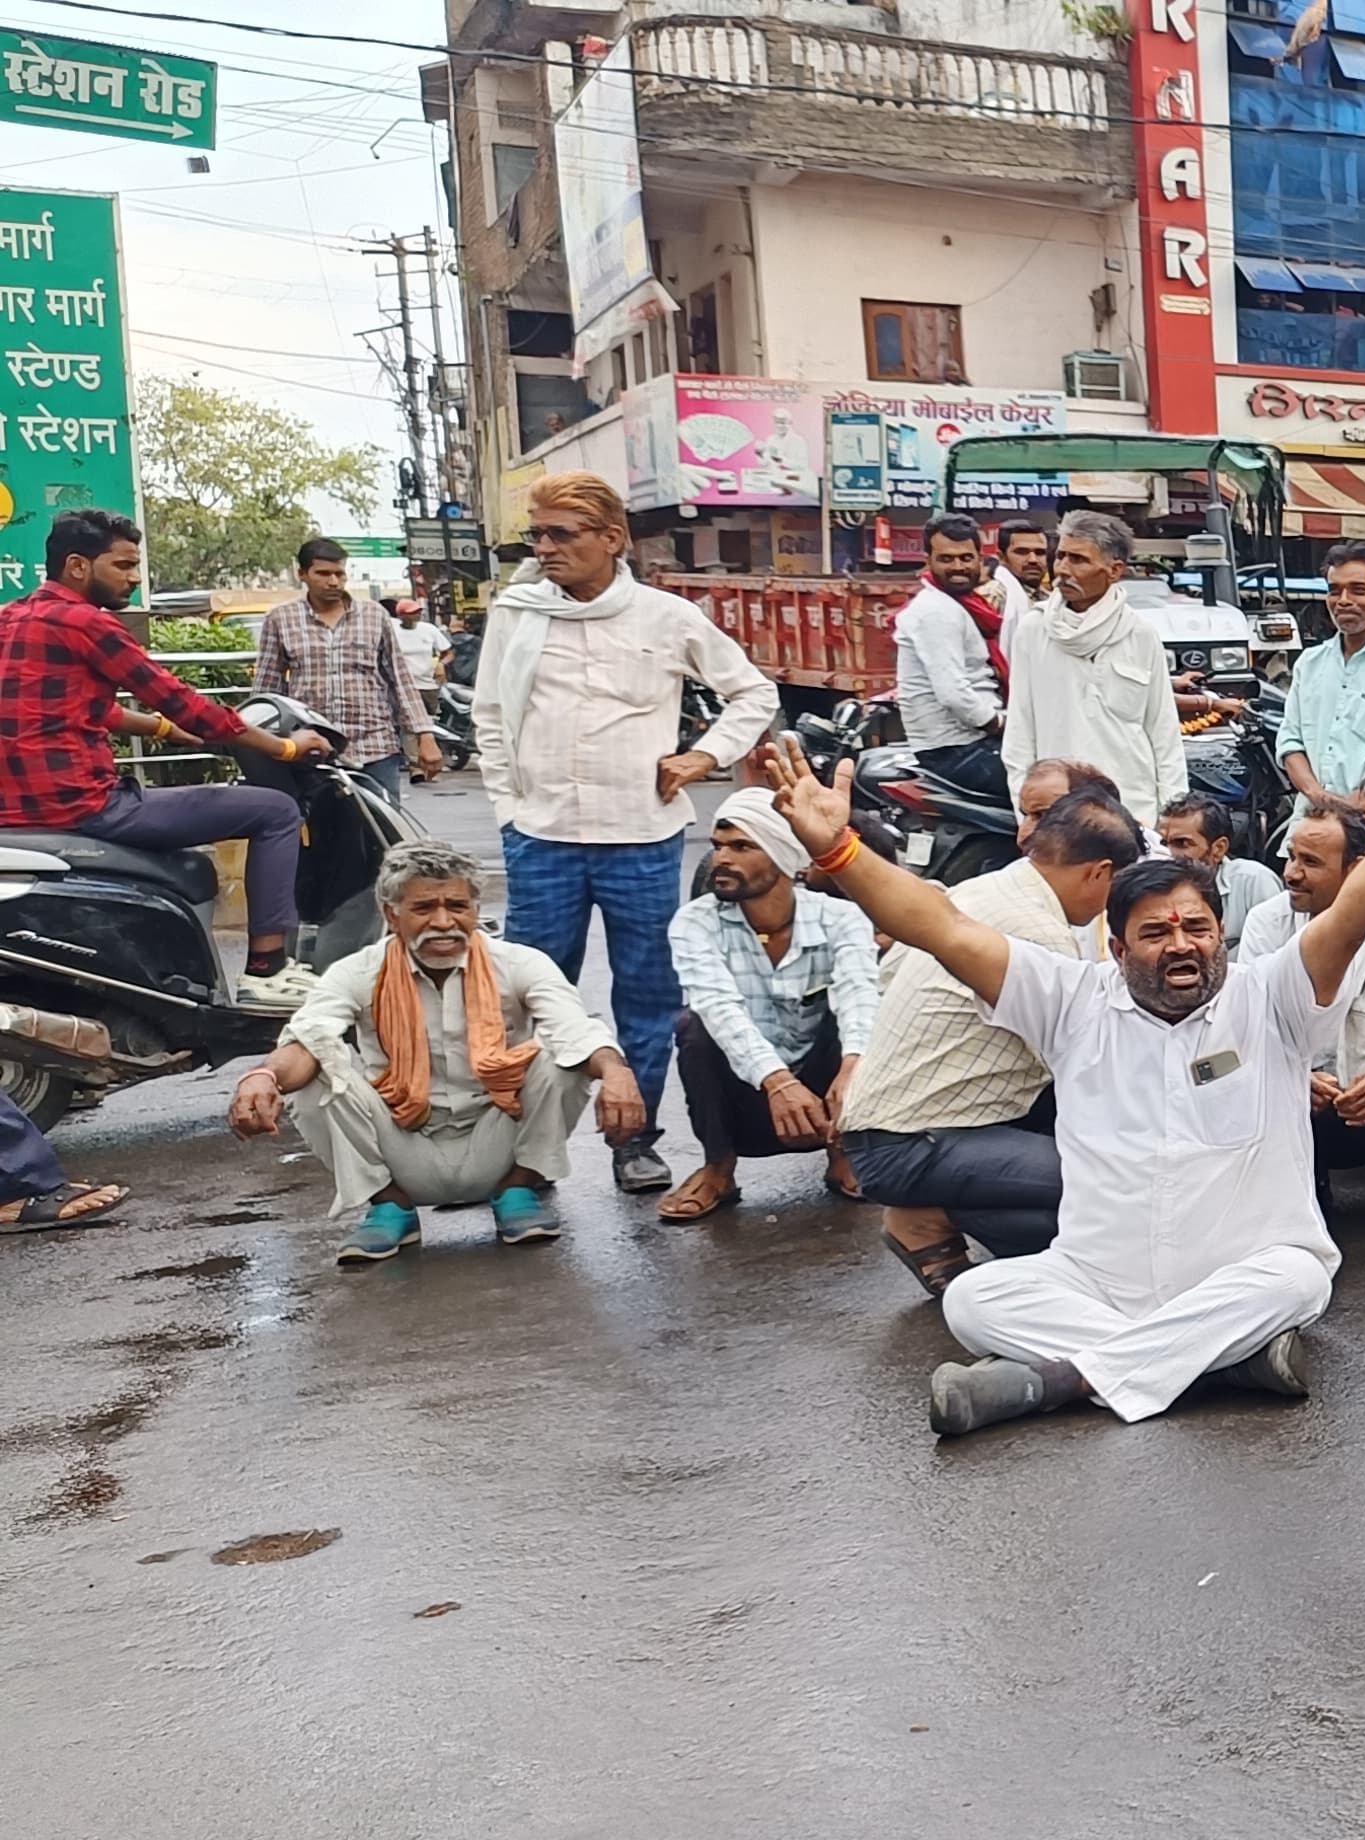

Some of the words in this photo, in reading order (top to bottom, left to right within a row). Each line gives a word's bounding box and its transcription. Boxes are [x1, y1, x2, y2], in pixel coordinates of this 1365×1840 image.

[3, 40, 128, 108] स्टेशन
[139, 58, 206, 118] रोड
[45, 278, 106, 327] मार्ग
[5, 341, 101, 391] स्टेण्ड
[17, 403, 118, 454] स्टेशन
